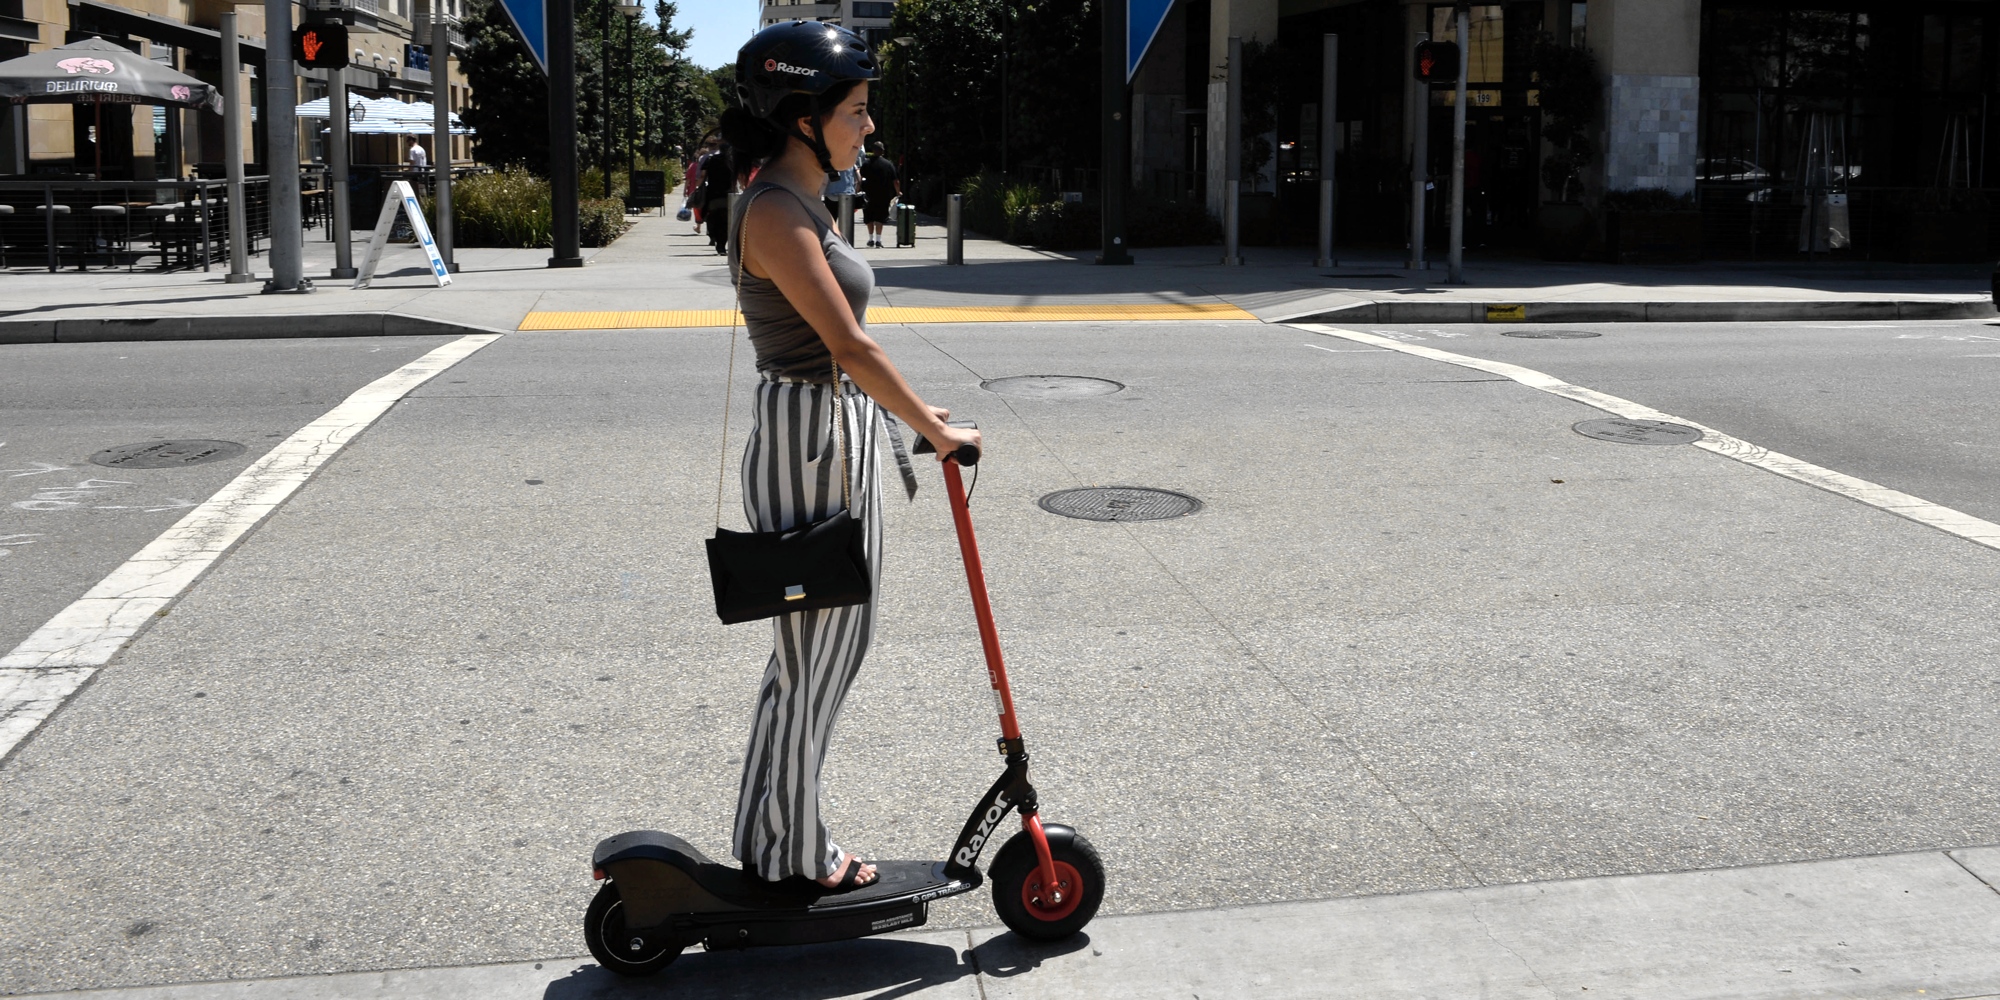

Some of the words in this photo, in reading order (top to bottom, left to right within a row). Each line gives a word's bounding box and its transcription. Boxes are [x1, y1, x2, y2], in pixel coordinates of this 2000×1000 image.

[777, 62, 819, 76] Razor
[46, 81, 118, 92] DELIRIUM
[1477, 94, 1490, 103] 199
[955, 790, 1008, 868] Razor
[921, 891, 937, 901] GPS
